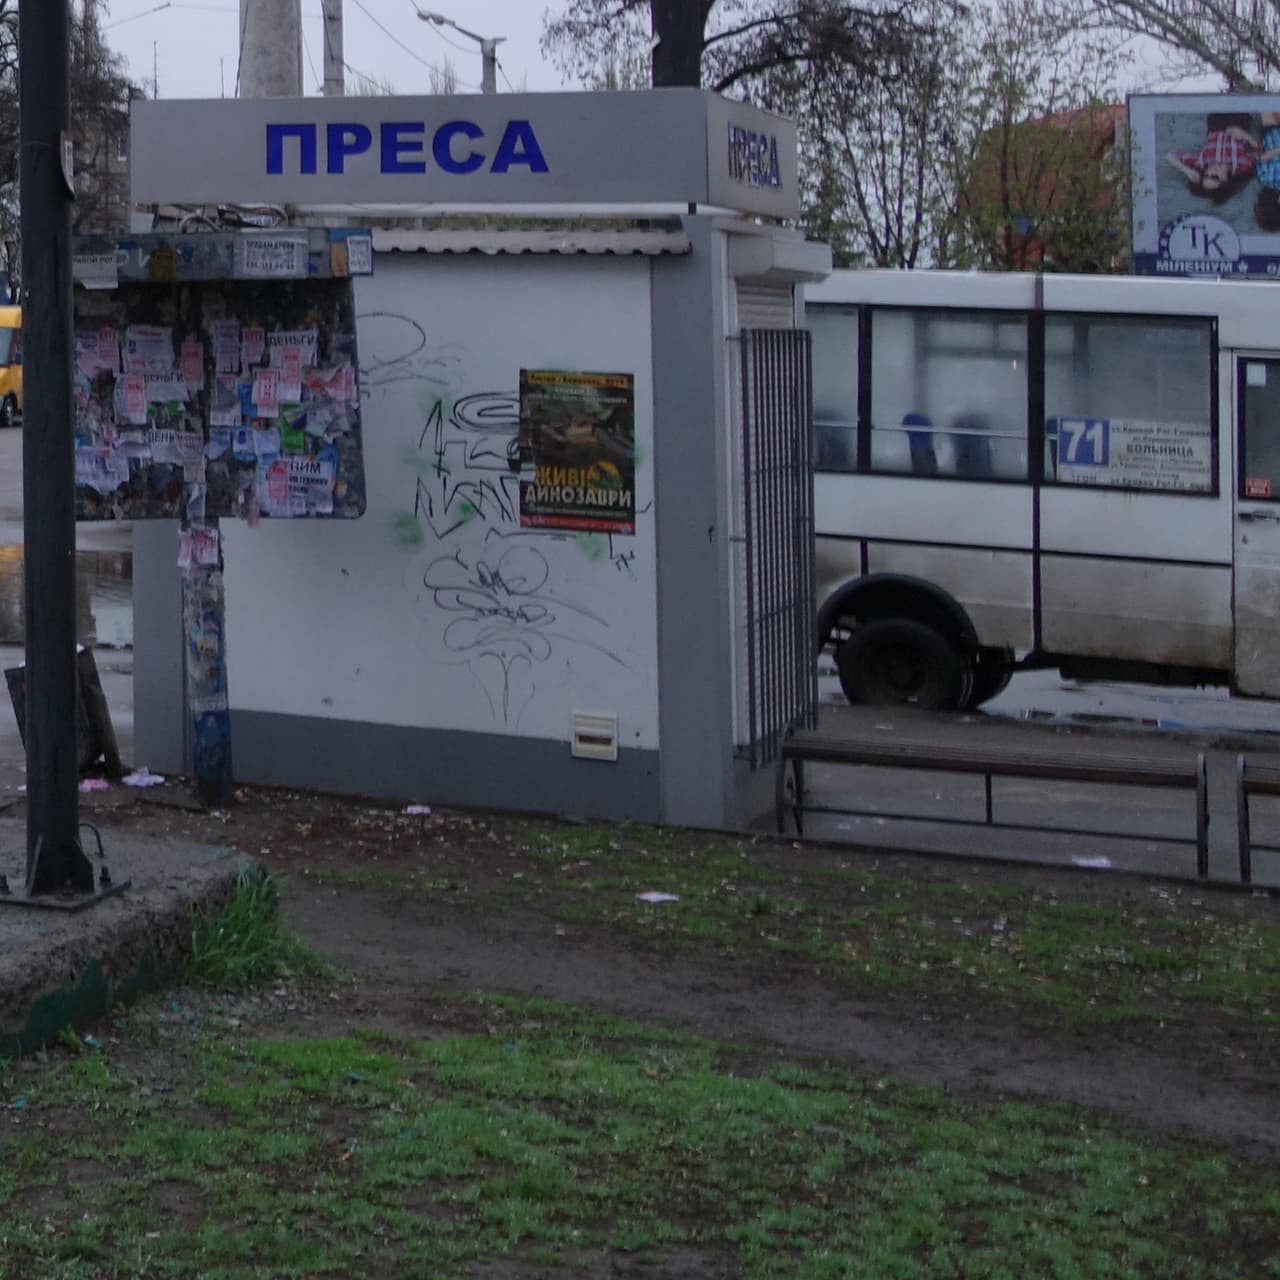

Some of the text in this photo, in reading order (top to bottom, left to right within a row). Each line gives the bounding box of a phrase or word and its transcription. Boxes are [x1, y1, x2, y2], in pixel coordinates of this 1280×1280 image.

[266, 120, 550, 175] ПРЕСА
[727, 120, 783, 191] ПРЕСА
[1062, 420, 1103, 464] 71
[525, 484, 631, 507] ДИНОЗАВРИ
